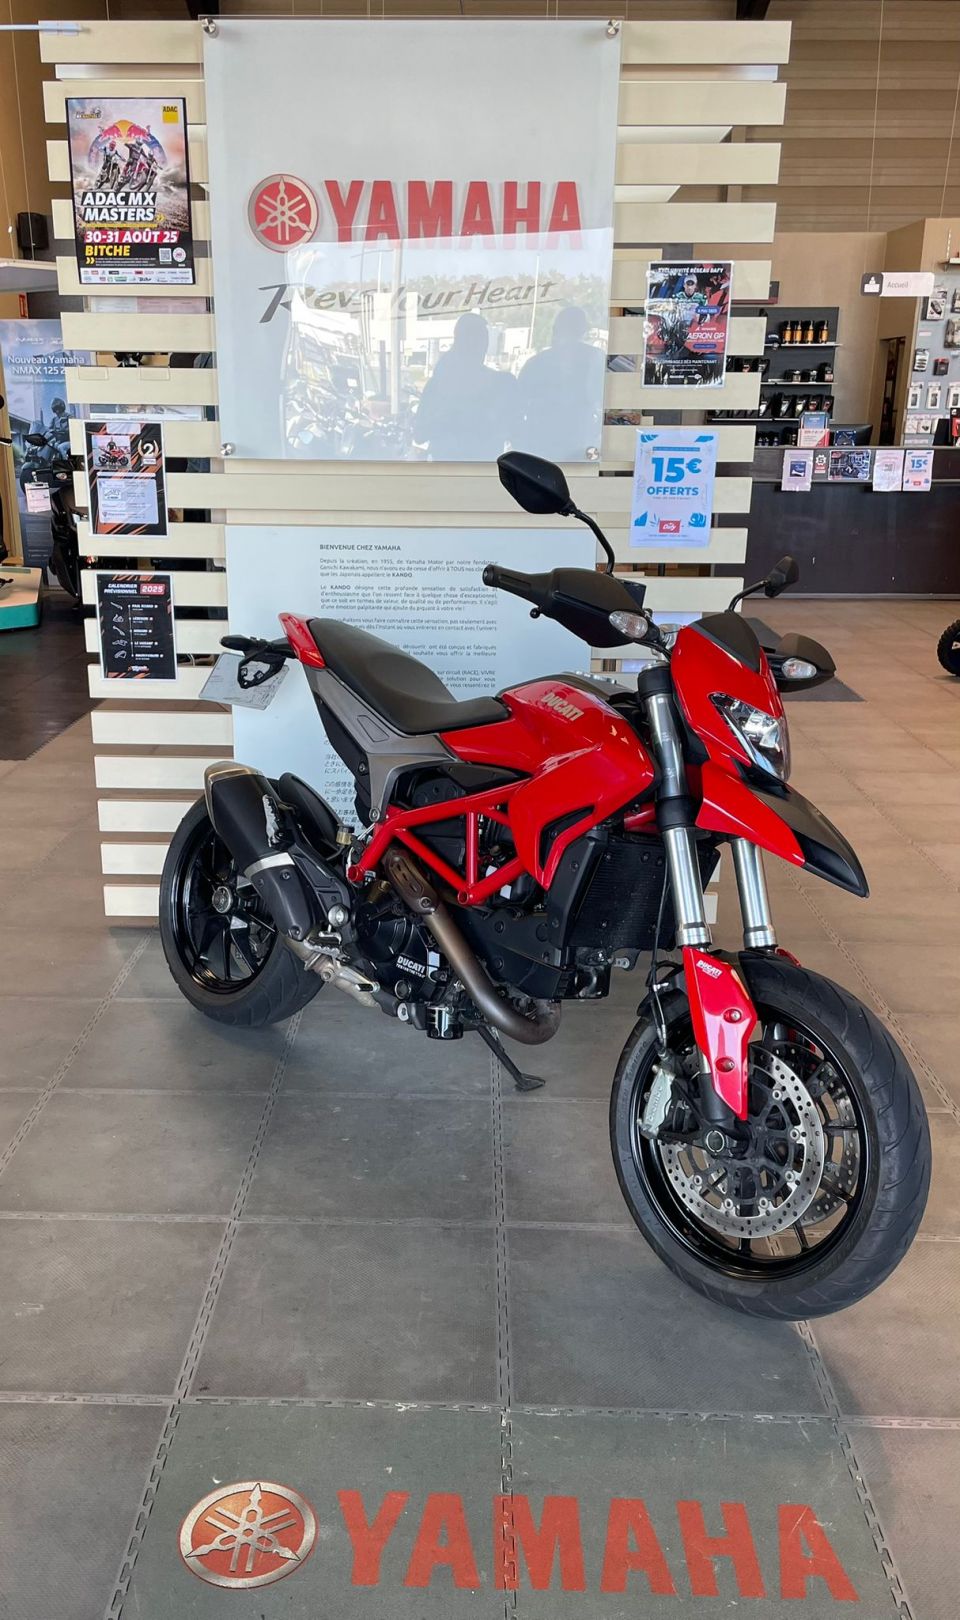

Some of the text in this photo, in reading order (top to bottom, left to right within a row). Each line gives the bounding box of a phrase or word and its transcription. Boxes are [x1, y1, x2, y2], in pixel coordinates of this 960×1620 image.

[83, 192, 155, 206] ADAC MX
[85, 208, 154, 221] MASTERS
[324, 180, 583, 249] YAMAHA
[86, 228, 178, 243] 30-31 AOÛT 25
[85, 245, 130, 256] BITCHE
[463, 281, 557, 306] Heart
[8, 355, 85, 364] Nouveau Yamaha
[12, 366, 42, 374] NMAX
[43, 366, 59, 374] 125
[651, 457, 702, 483] 15€
[647, 486, 699, 496] OFFERTS
[142, 585, 163, 593] 2025
[541, 692, 585, 721] DUCATI
[397, 955, 425, 974] DUCATI
[337, 1488, 860, 1601] YAMAHA
